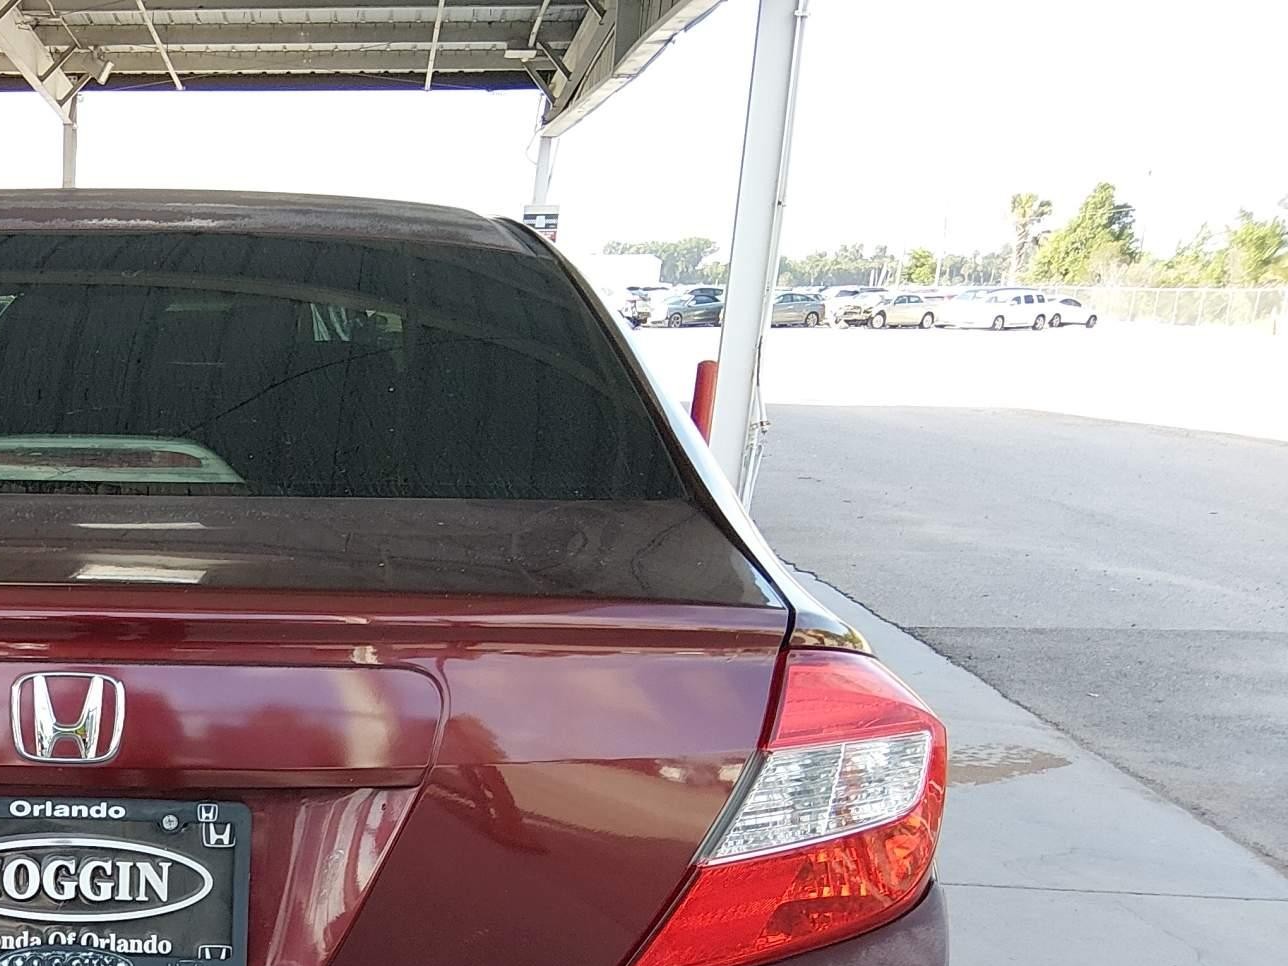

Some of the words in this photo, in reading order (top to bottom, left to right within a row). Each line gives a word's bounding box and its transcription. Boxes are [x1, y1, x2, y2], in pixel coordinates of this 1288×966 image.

[9, 800, 126, 819] Orlando
[48, 931, 76, 946] Of
[80, 932, 172, 954] Orlando
